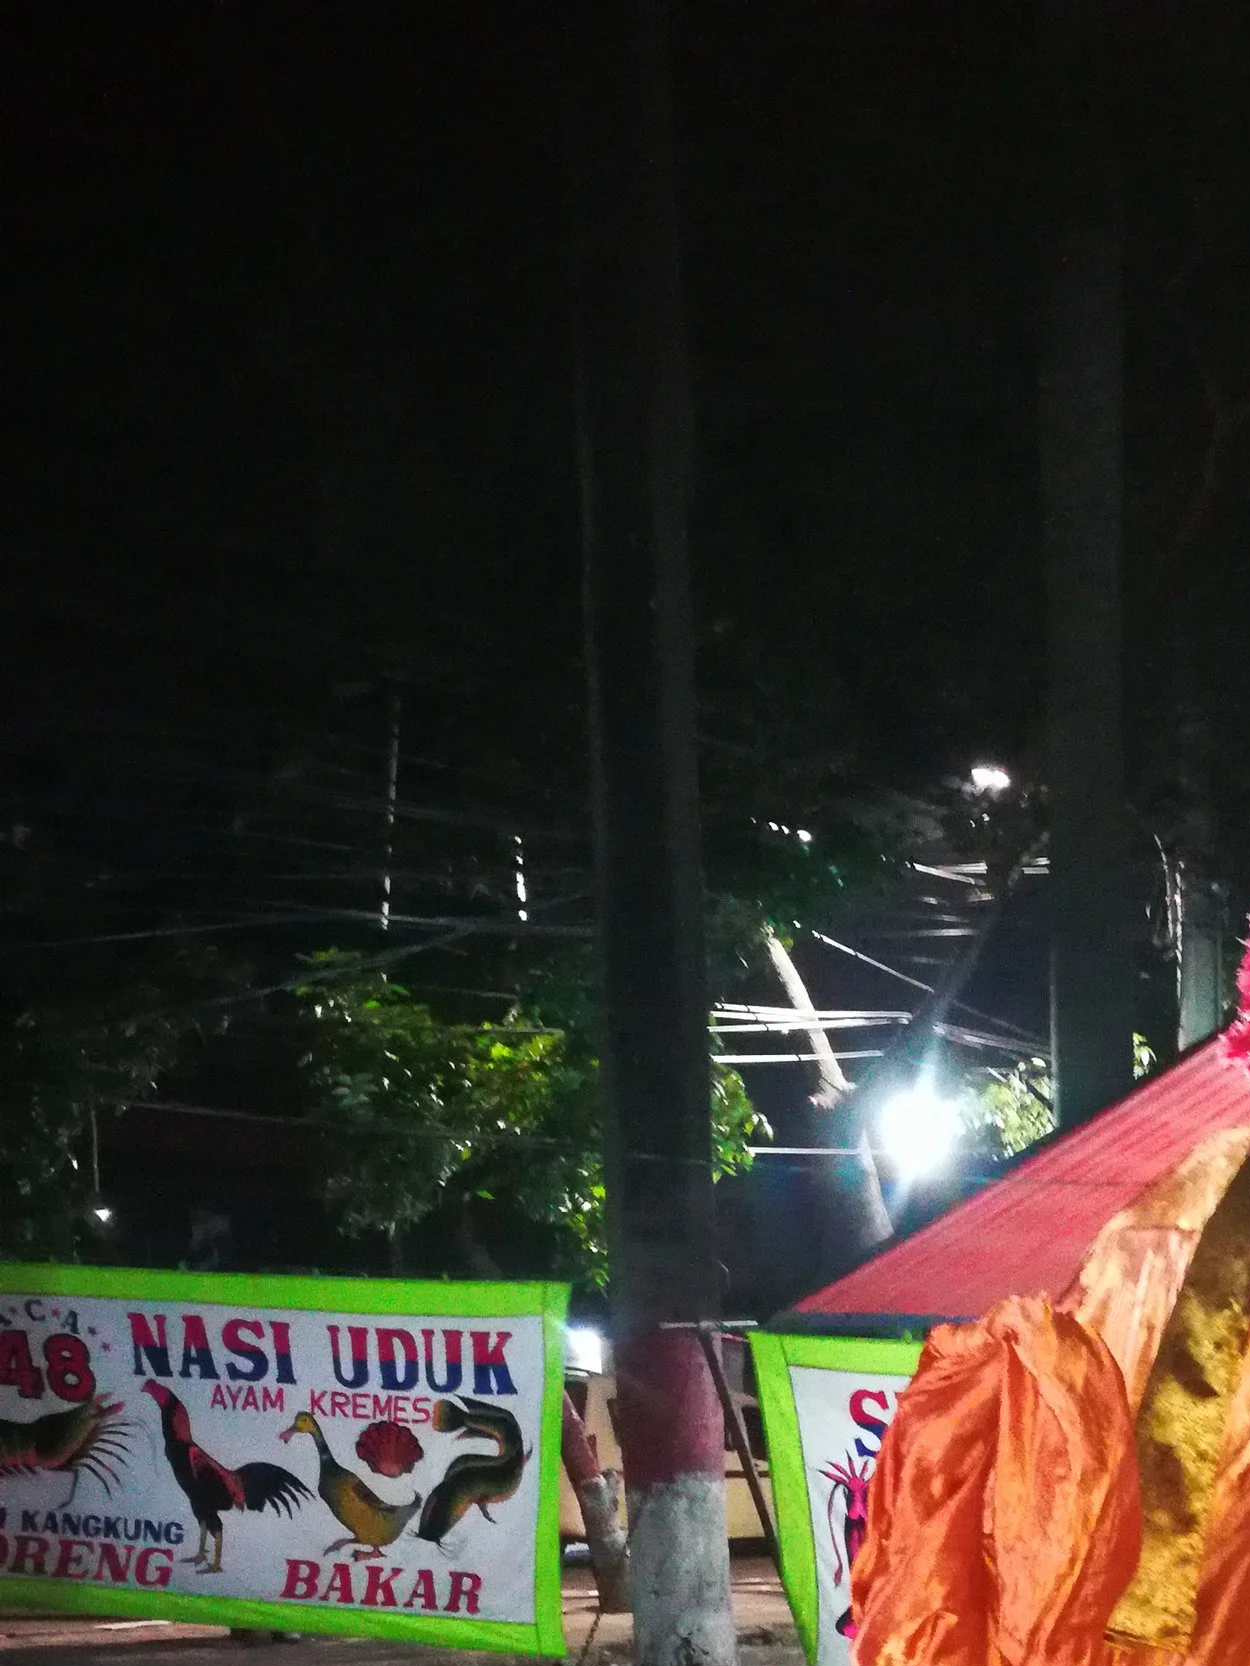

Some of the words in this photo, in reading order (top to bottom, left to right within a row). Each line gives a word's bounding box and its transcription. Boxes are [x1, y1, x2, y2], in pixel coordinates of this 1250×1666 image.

[127, 1312, 297, 1385] NASI
[327, 1324, 518, 1396] UDUK
[210, 1384, 285, 1413] AYAM
[309, 1388, 432, 1424] KREMES
[21, 1510, 185, 1545] KANGKUNG
[280, 1558, 483, 1615] BAKAR
